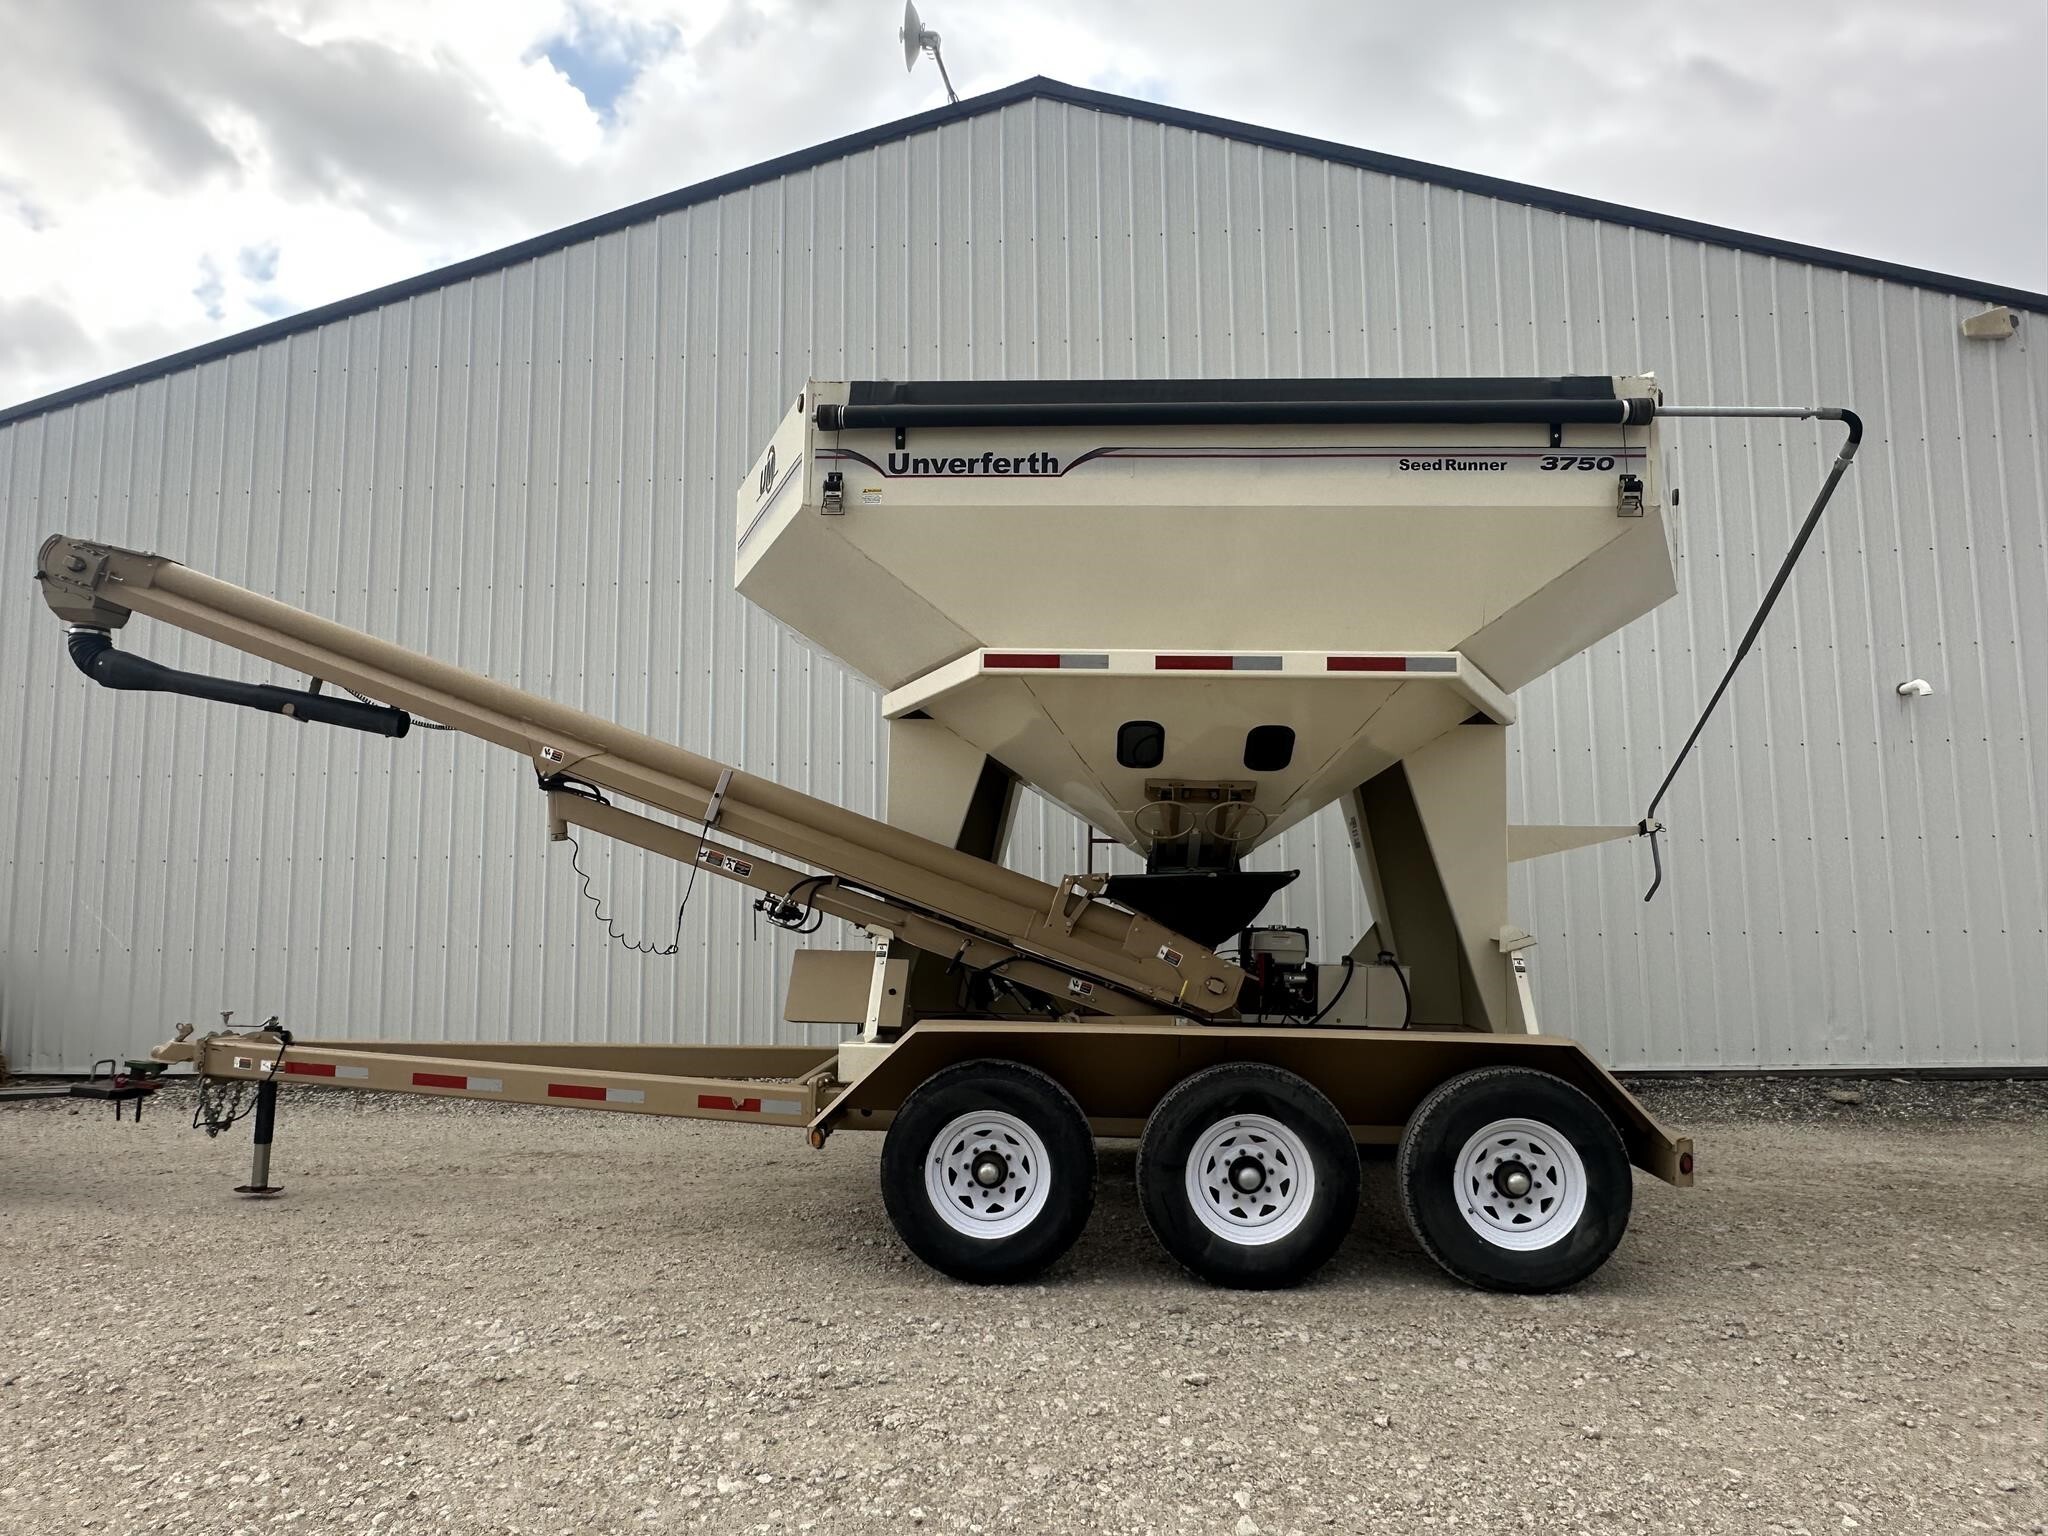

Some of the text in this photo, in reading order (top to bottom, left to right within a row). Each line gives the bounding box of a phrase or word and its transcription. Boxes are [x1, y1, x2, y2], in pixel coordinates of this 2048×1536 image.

[888, 452, 1058, 474] Unverferth
[1399, 459, 1508, 471] Seed Runner
[1540, 456, 1615, 471] 3750
